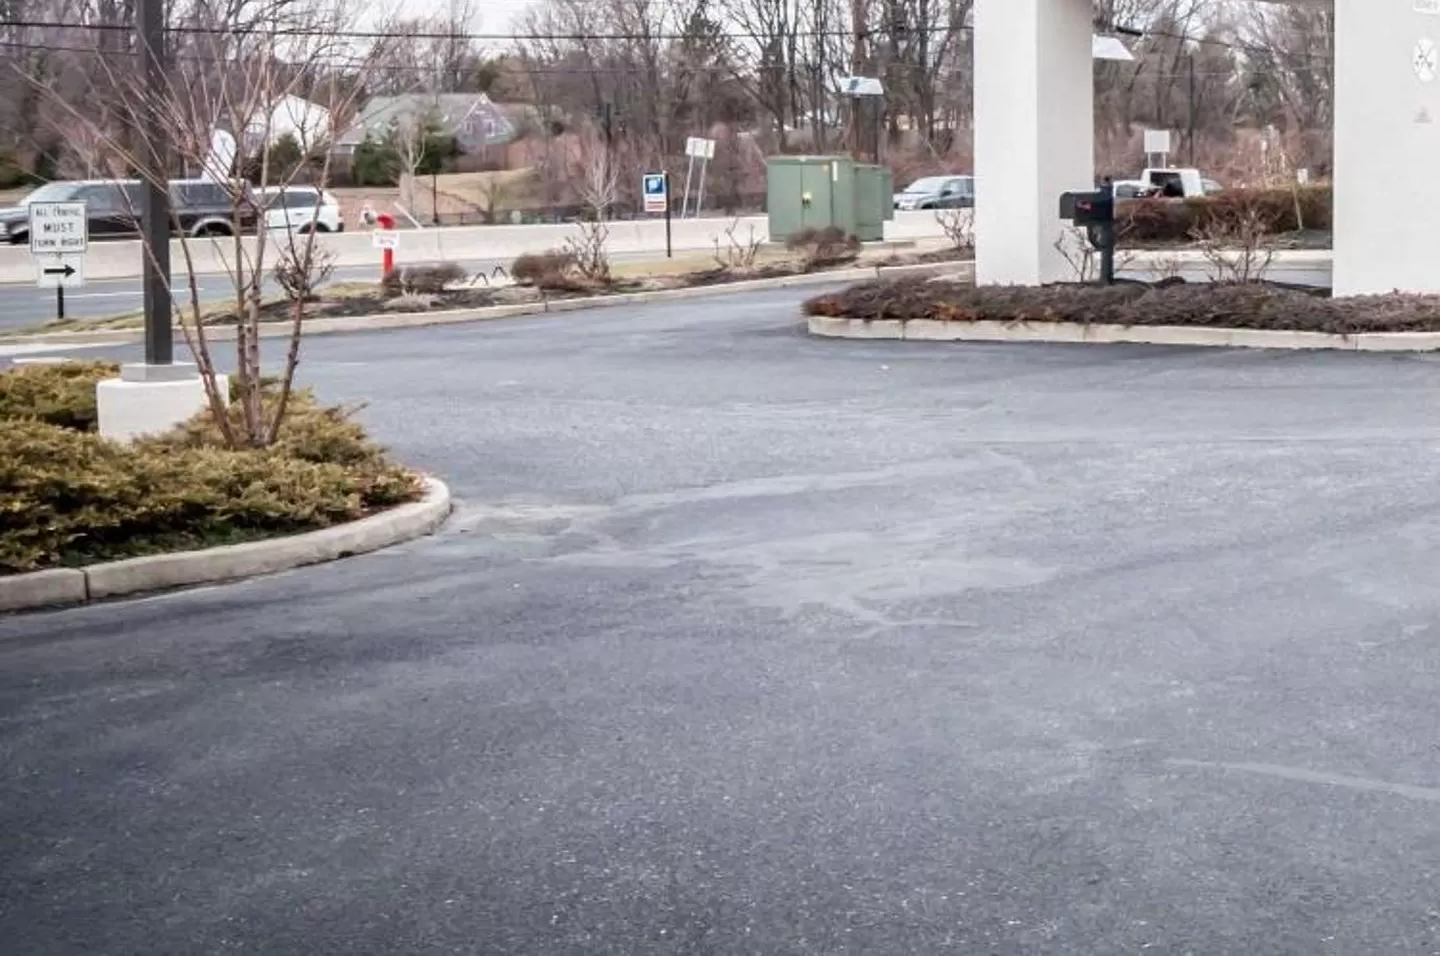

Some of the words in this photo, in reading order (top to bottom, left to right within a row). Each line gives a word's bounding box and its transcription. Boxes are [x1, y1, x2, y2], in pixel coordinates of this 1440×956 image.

[35, 207, 48, 217] ALL
[43, 222, 74, 233] MUST
[33, 237, 56, 248] TURN
